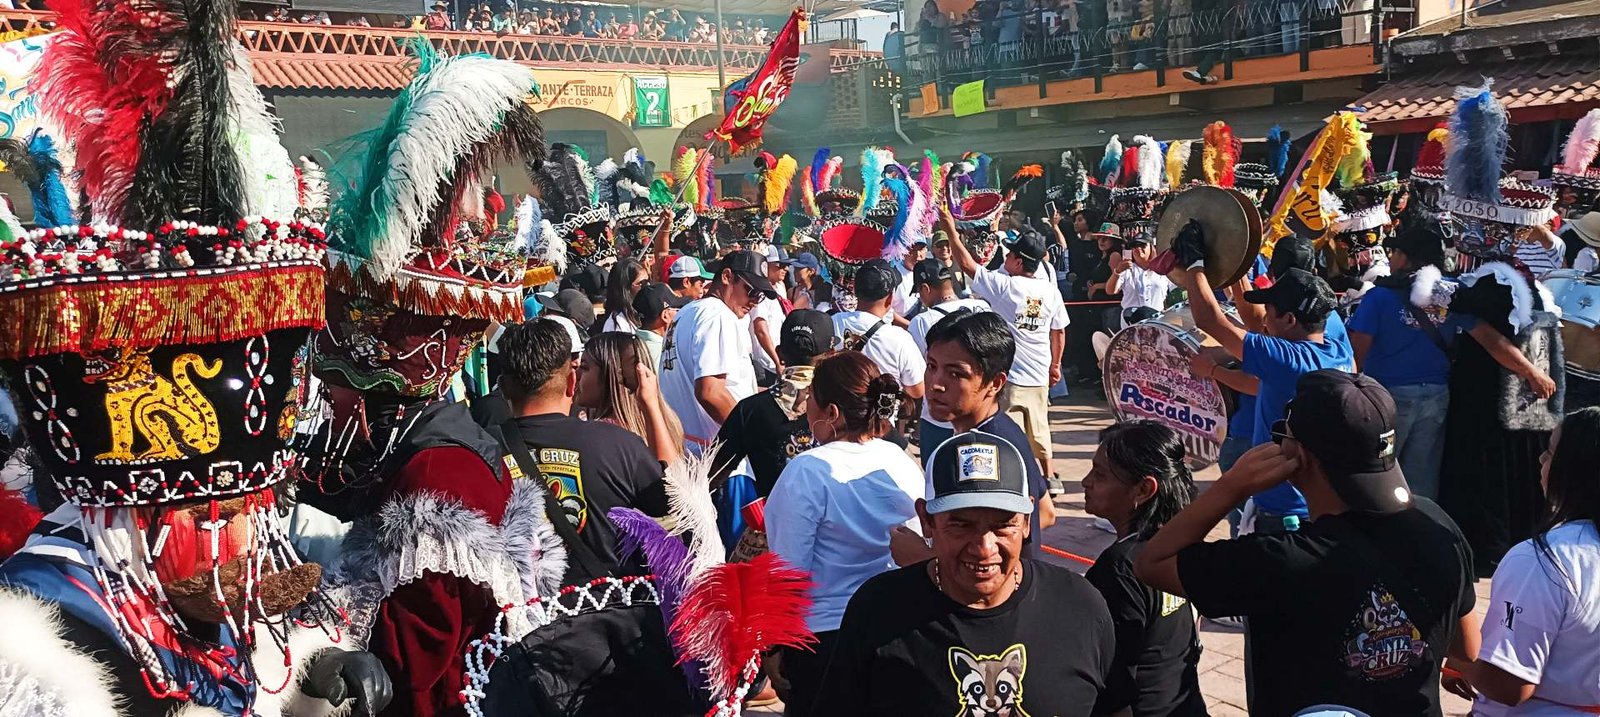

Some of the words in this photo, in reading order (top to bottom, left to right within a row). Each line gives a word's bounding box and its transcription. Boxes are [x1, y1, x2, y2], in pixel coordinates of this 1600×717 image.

[574, 85, 614, 97] TERRAZA
[645, 92, 660, 115] 2
[1120, 383, 1217, 432] Pescador
[541, 448, 580, 466] CRUZ
[1362, 636, 1412, 657] SANTA
[1363, 650, 1410, 672] CRUZ
